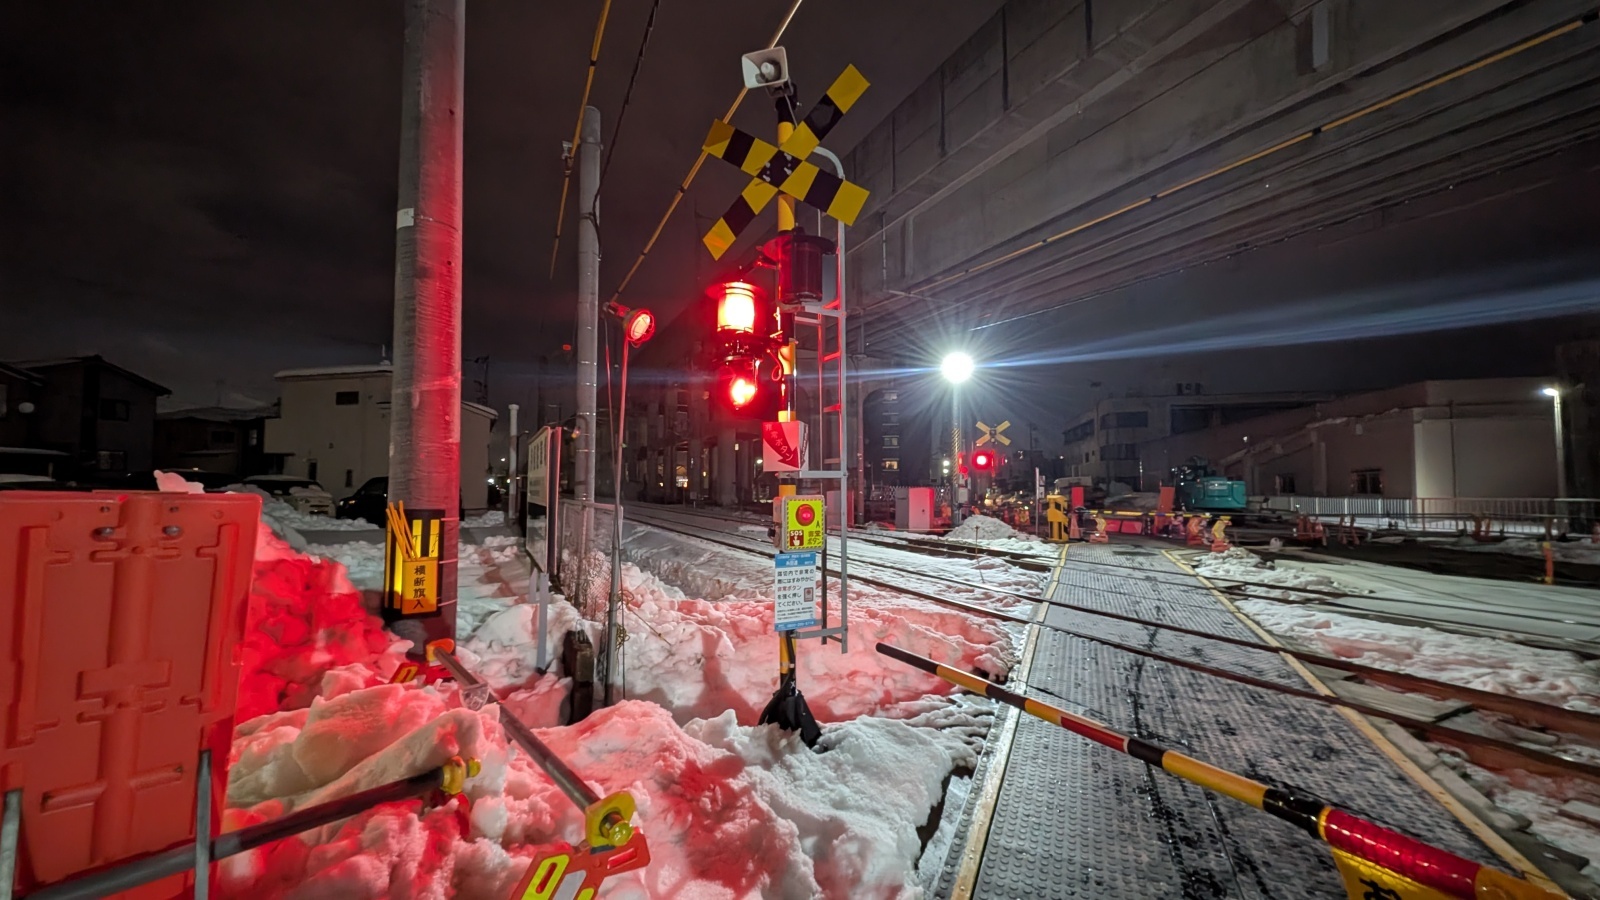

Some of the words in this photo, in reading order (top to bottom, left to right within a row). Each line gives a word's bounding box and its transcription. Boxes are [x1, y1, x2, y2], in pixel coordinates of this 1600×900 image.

[765, 424, 793, 461] 非常ボタン
[413, 565, 426, 610] 横断旗入
[777, 569, 815, 577] 踏切内で非常の
